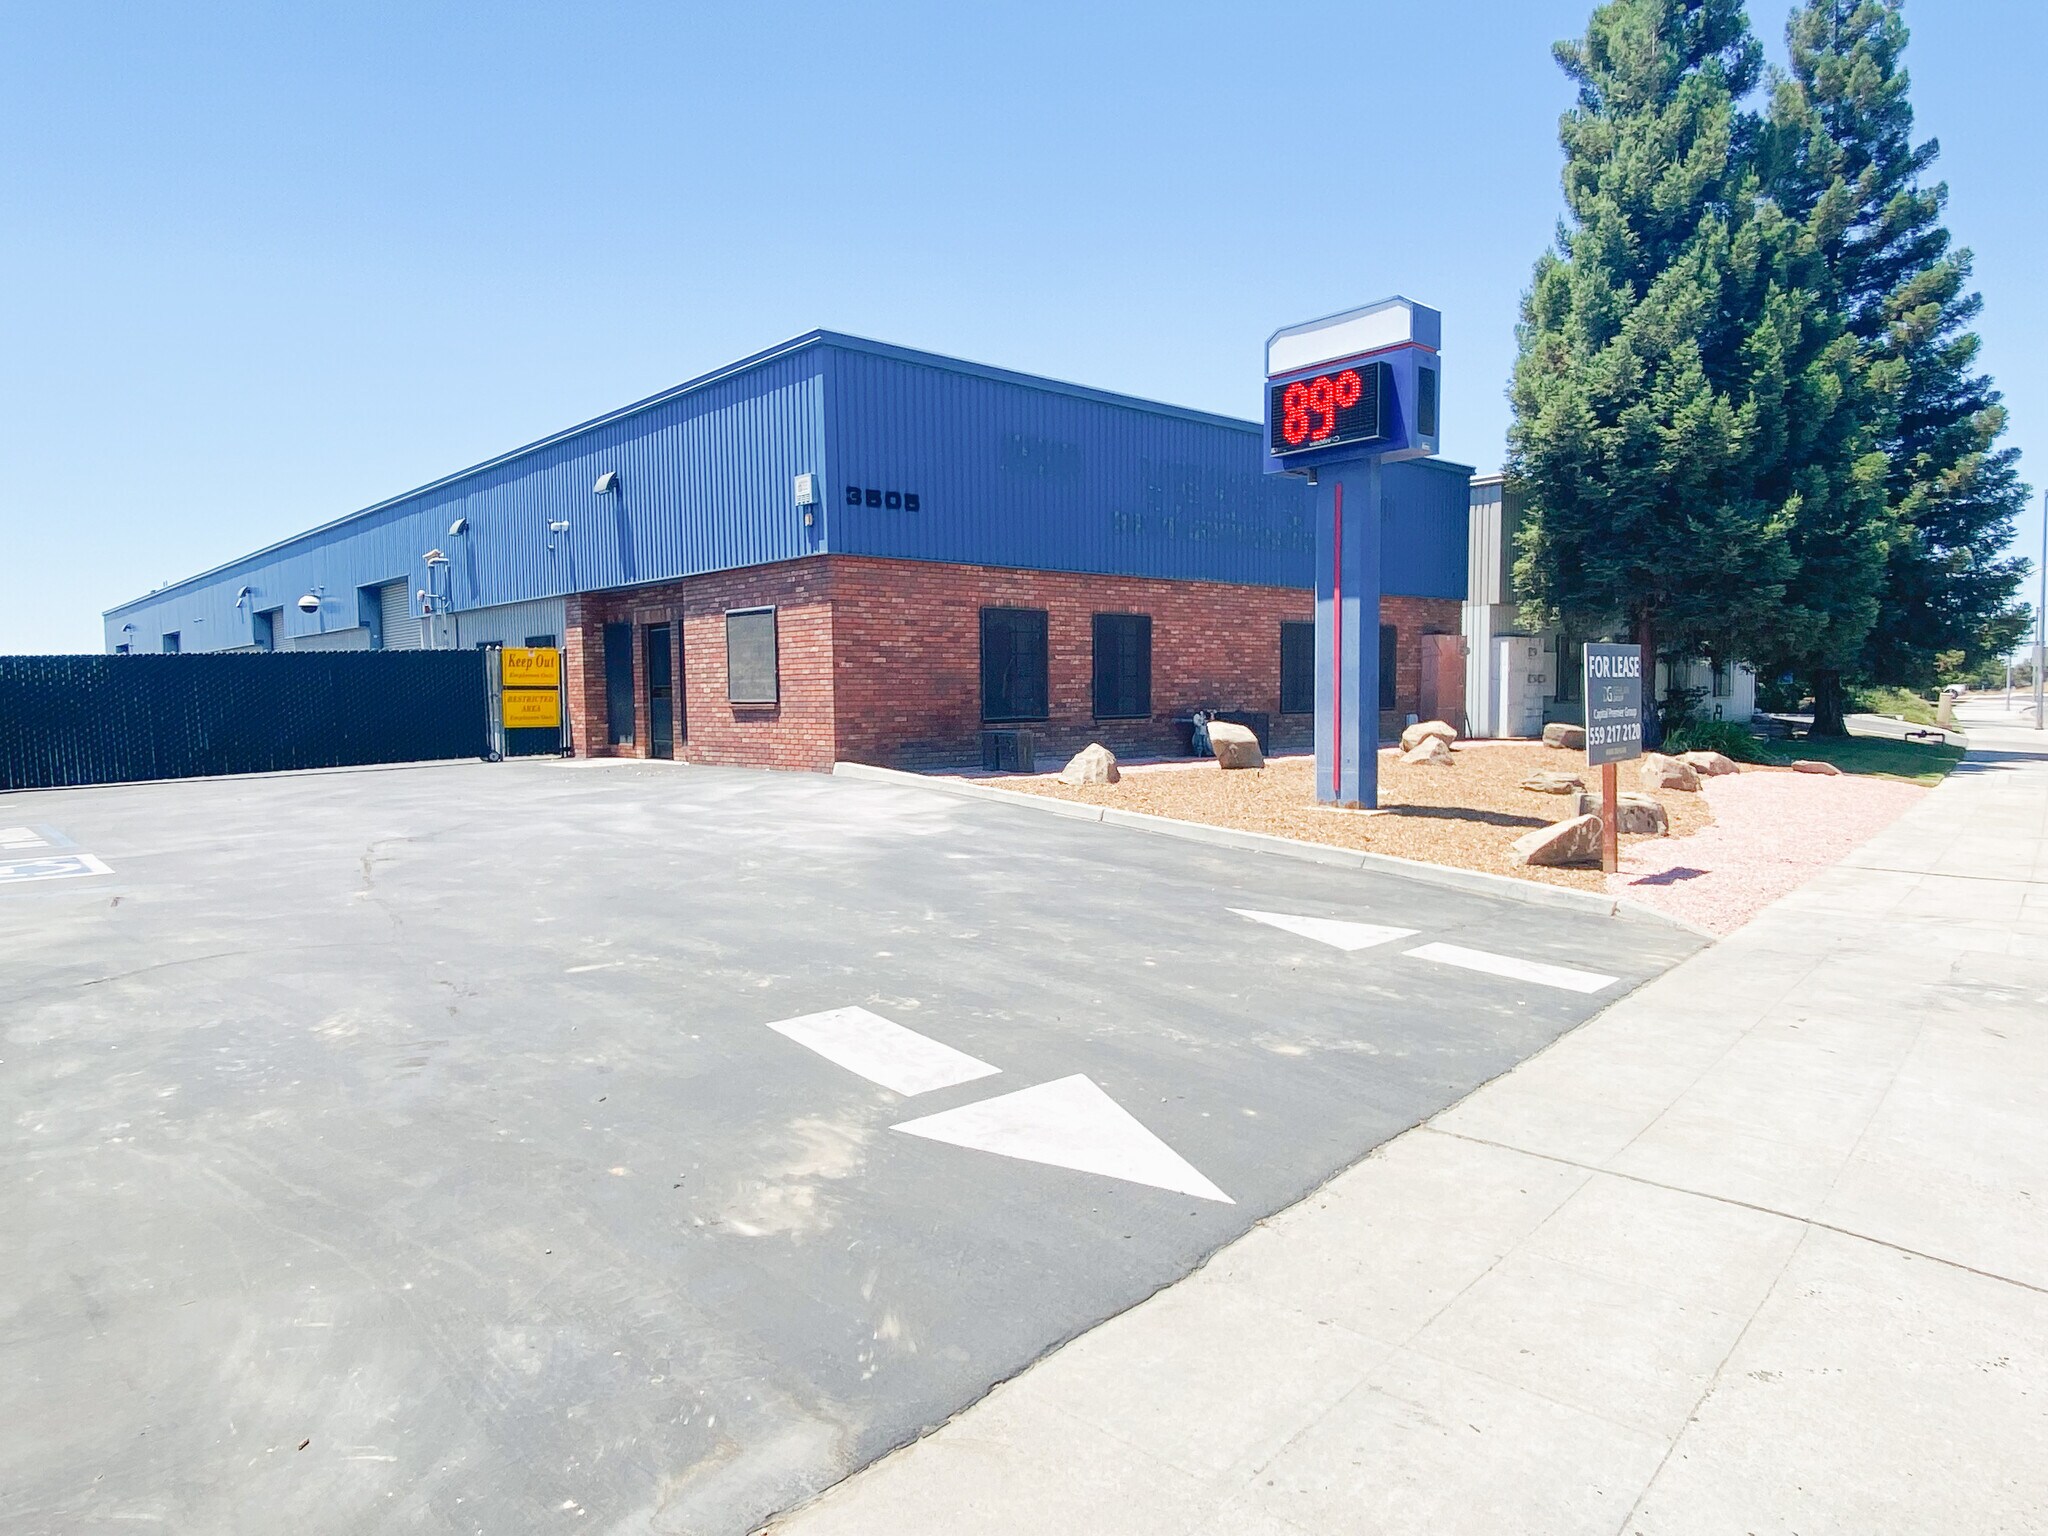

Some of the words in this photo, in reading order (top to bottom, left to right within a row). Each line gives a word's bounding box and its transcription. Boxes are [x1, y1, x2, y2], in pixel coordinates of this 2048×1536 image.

[846, 486, 920, 512] 3505
[508, 653, 533, 671] Keep
[536, 654, 554, 668] Out
[1589, 656, 1611, 678] FOR
[1612, 656, 1640, 678] LEASE
[1589, 726, 1605, 746] 559
[1606, 724, 1621, 744] 217
[1622, 722, 1641, 742] 2120
